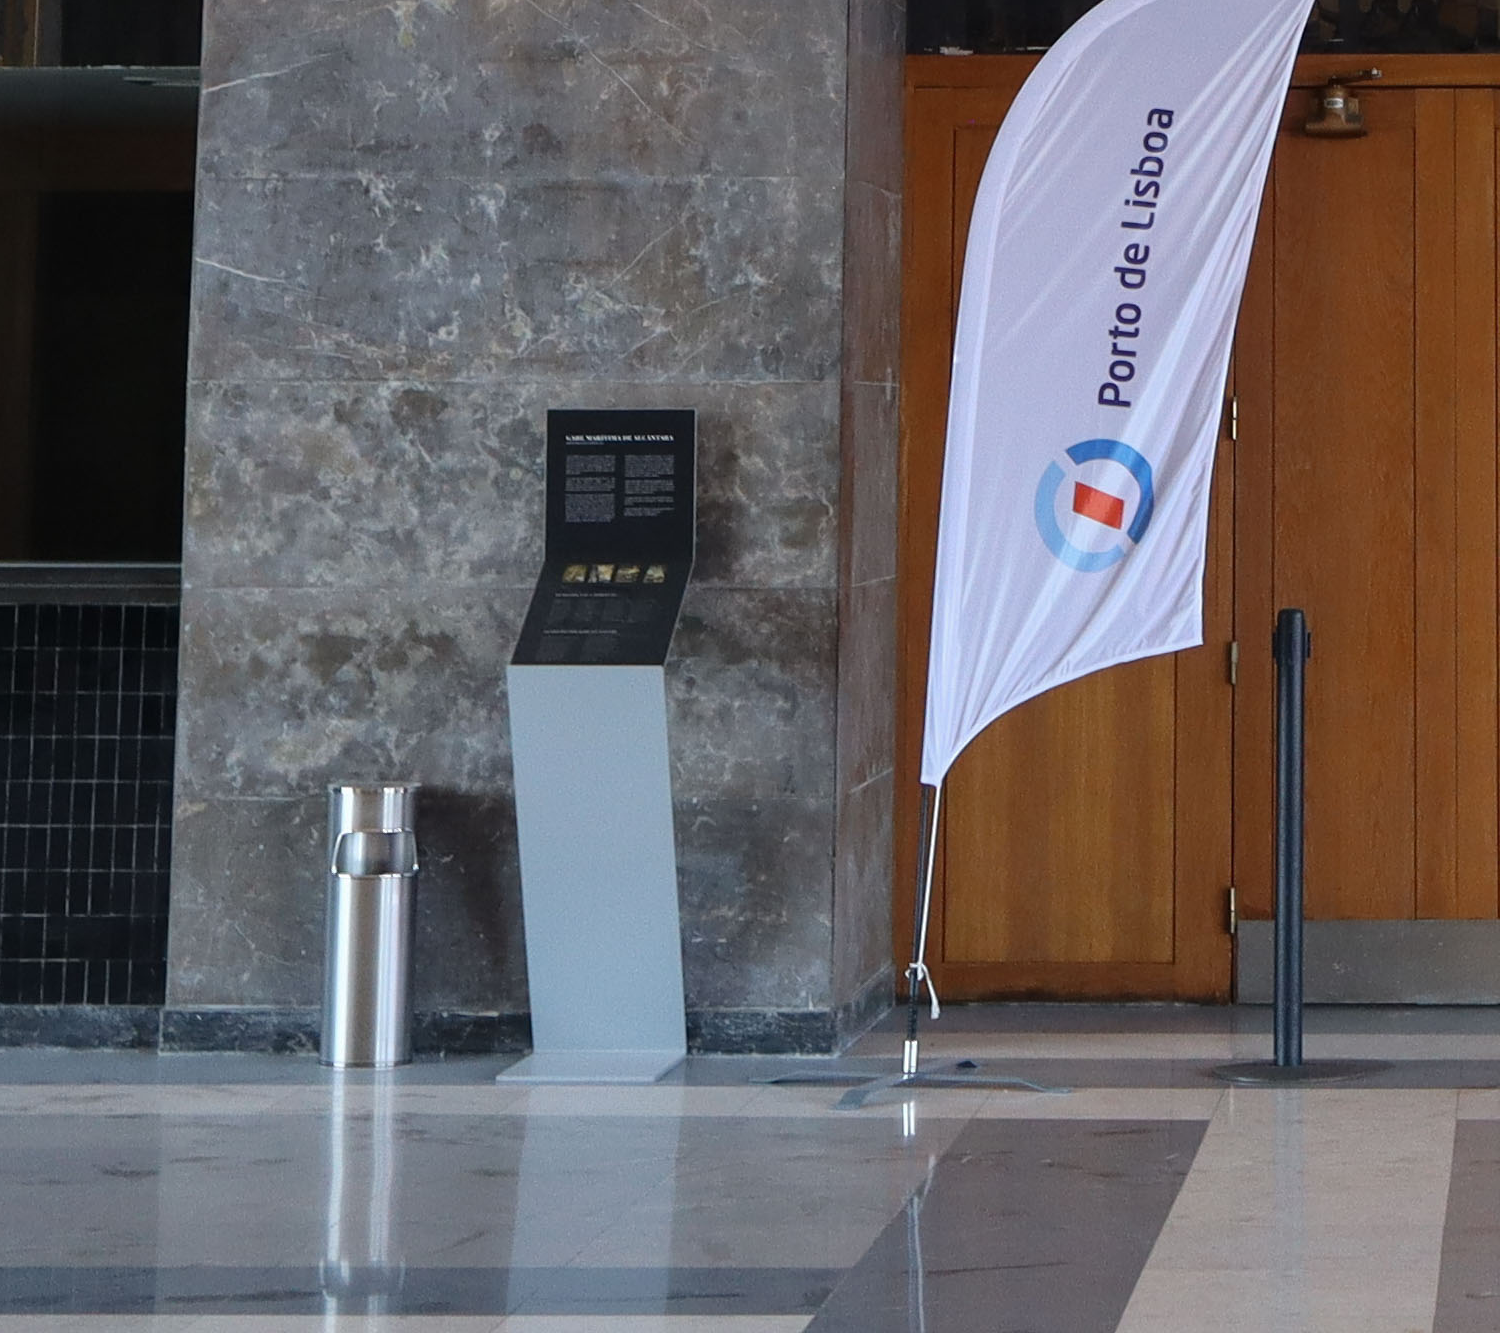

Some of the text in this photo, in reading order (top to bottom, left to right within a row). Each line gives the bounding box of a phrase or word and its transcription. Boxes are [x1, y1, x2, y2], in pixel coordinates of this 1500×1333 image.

[1098, 108, 1174, 407] Porto de Lisboa
